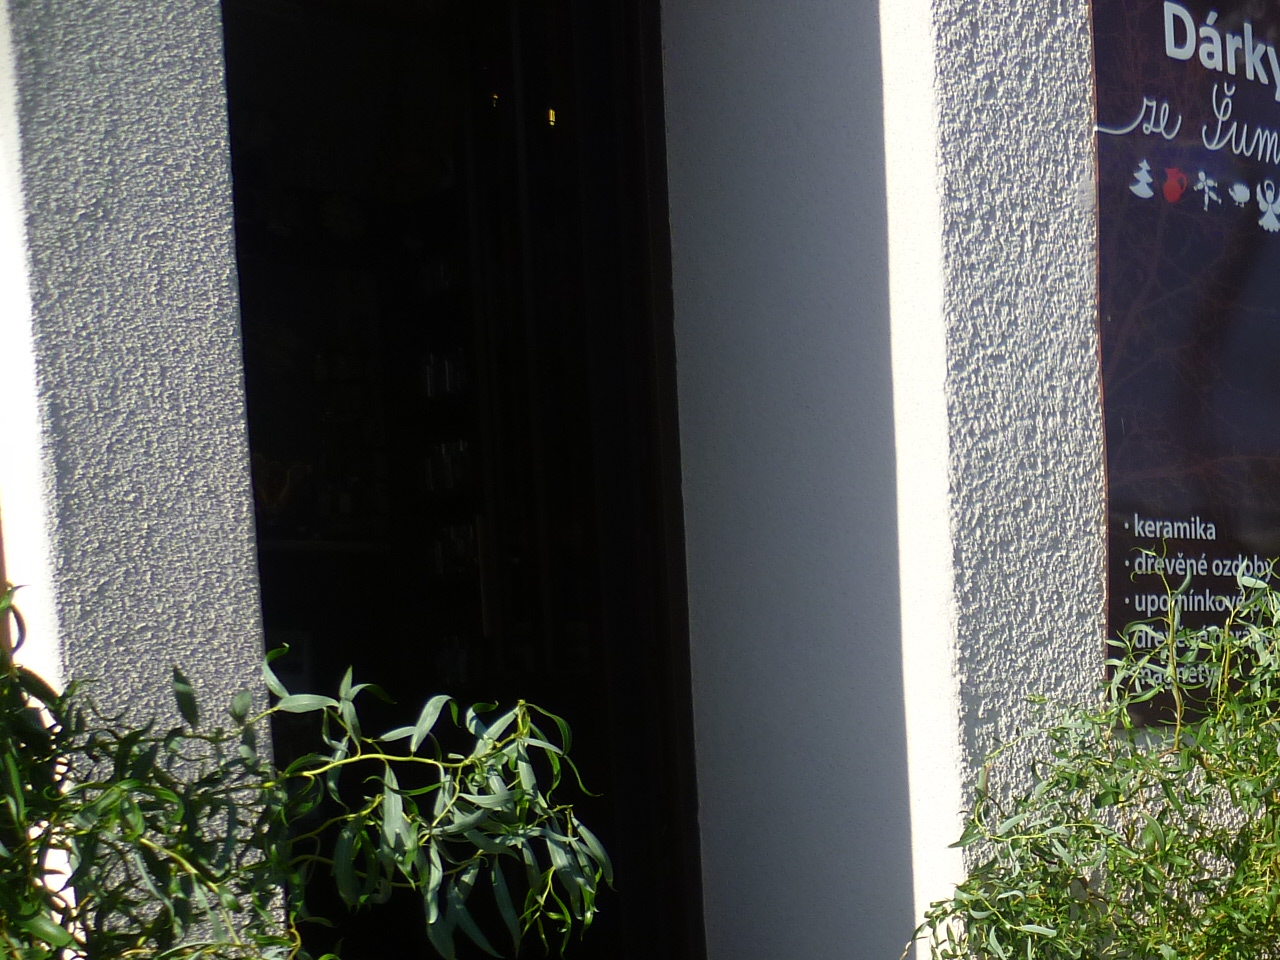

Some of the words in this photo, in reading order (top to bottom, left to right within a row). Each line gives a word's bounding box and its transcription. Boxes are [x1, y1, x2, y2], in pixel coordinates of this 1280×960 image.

[1134, 513, 1216, 541] keramika
[1134, 551, 1208, 576] dřevěné
[1212, 554, 1273, 583] ozdoby
[1135, 624, 1208, 648] dřeěé
